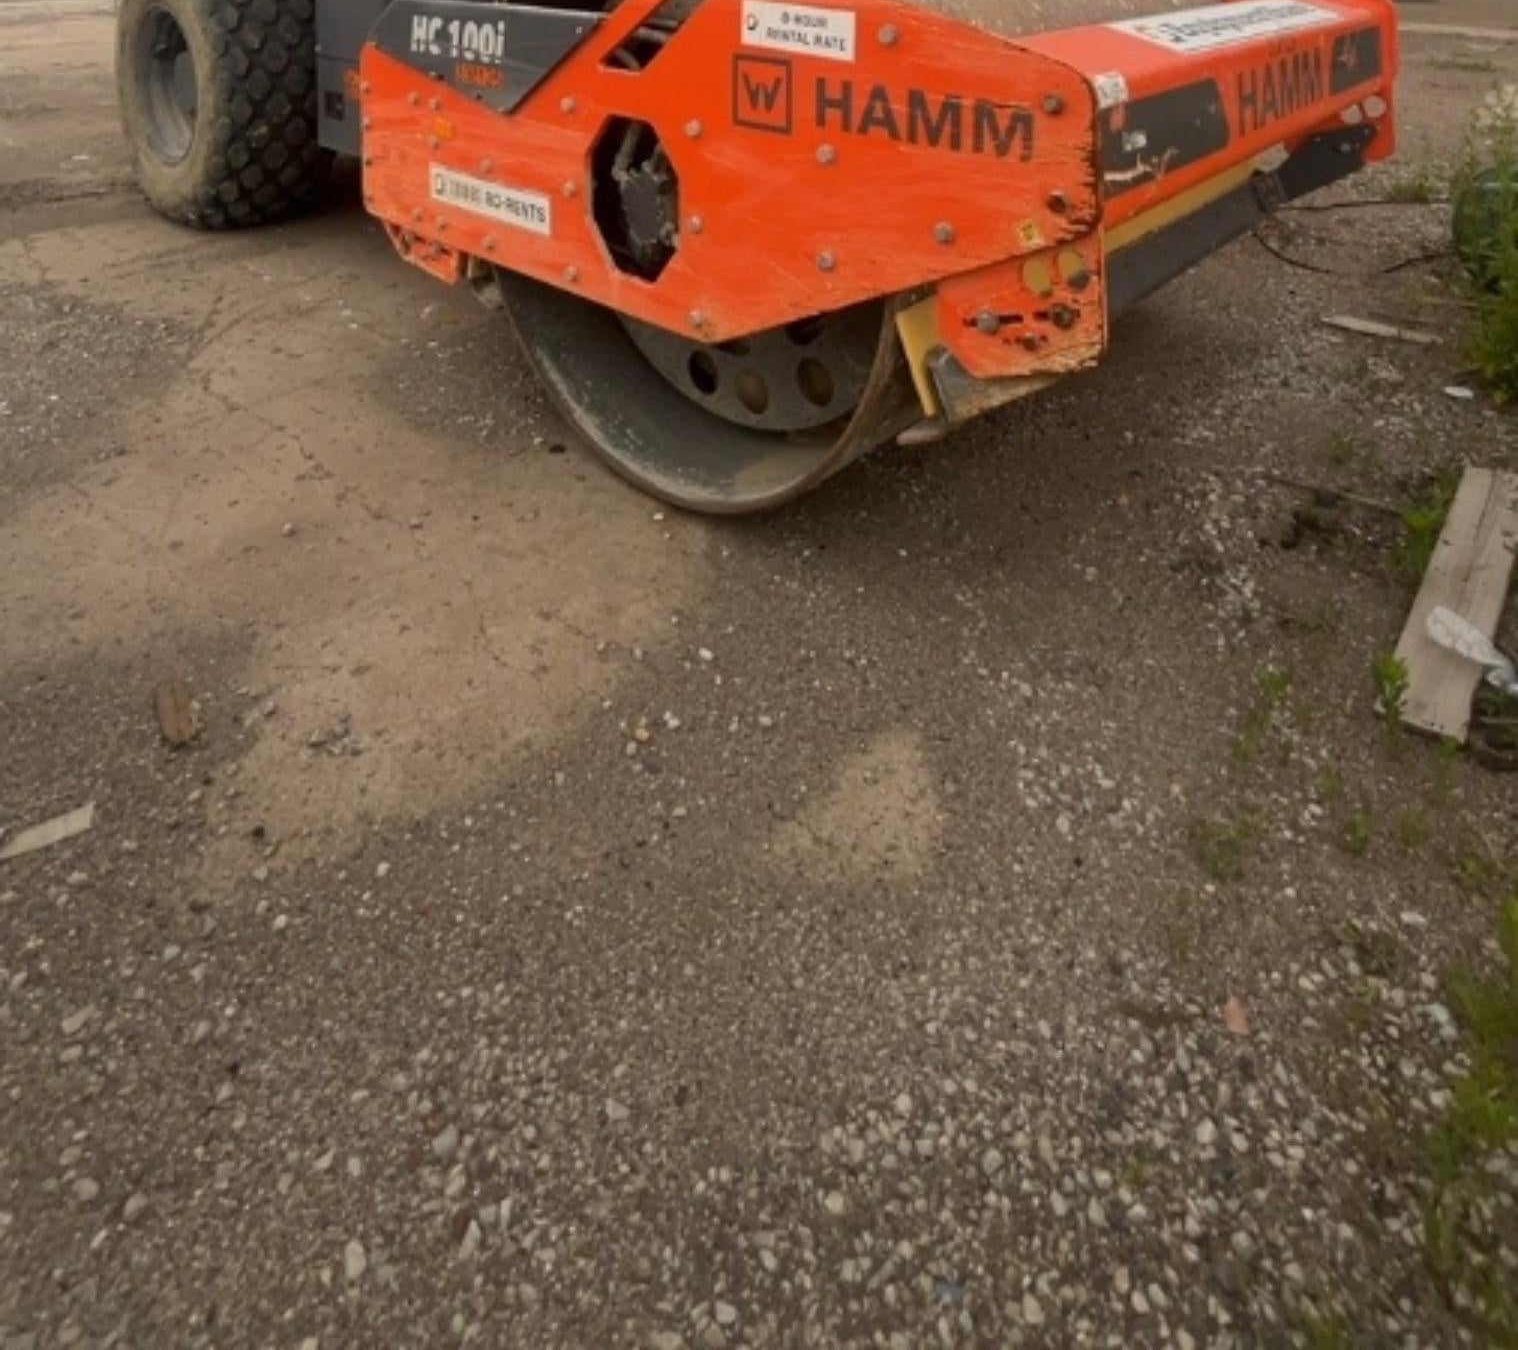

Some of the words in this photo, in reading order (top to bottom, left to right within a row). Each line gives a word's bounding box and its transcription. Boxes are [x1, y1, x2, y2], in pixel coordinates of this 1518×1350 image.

[411, 14, 443, 55] HC
[766, 26, 810, 46] RENTAL
[813, 33, 847, 52] RATE
[816, 77, 1036, 163] HAMM
[1238, 47, 1323, 138] HAMM
